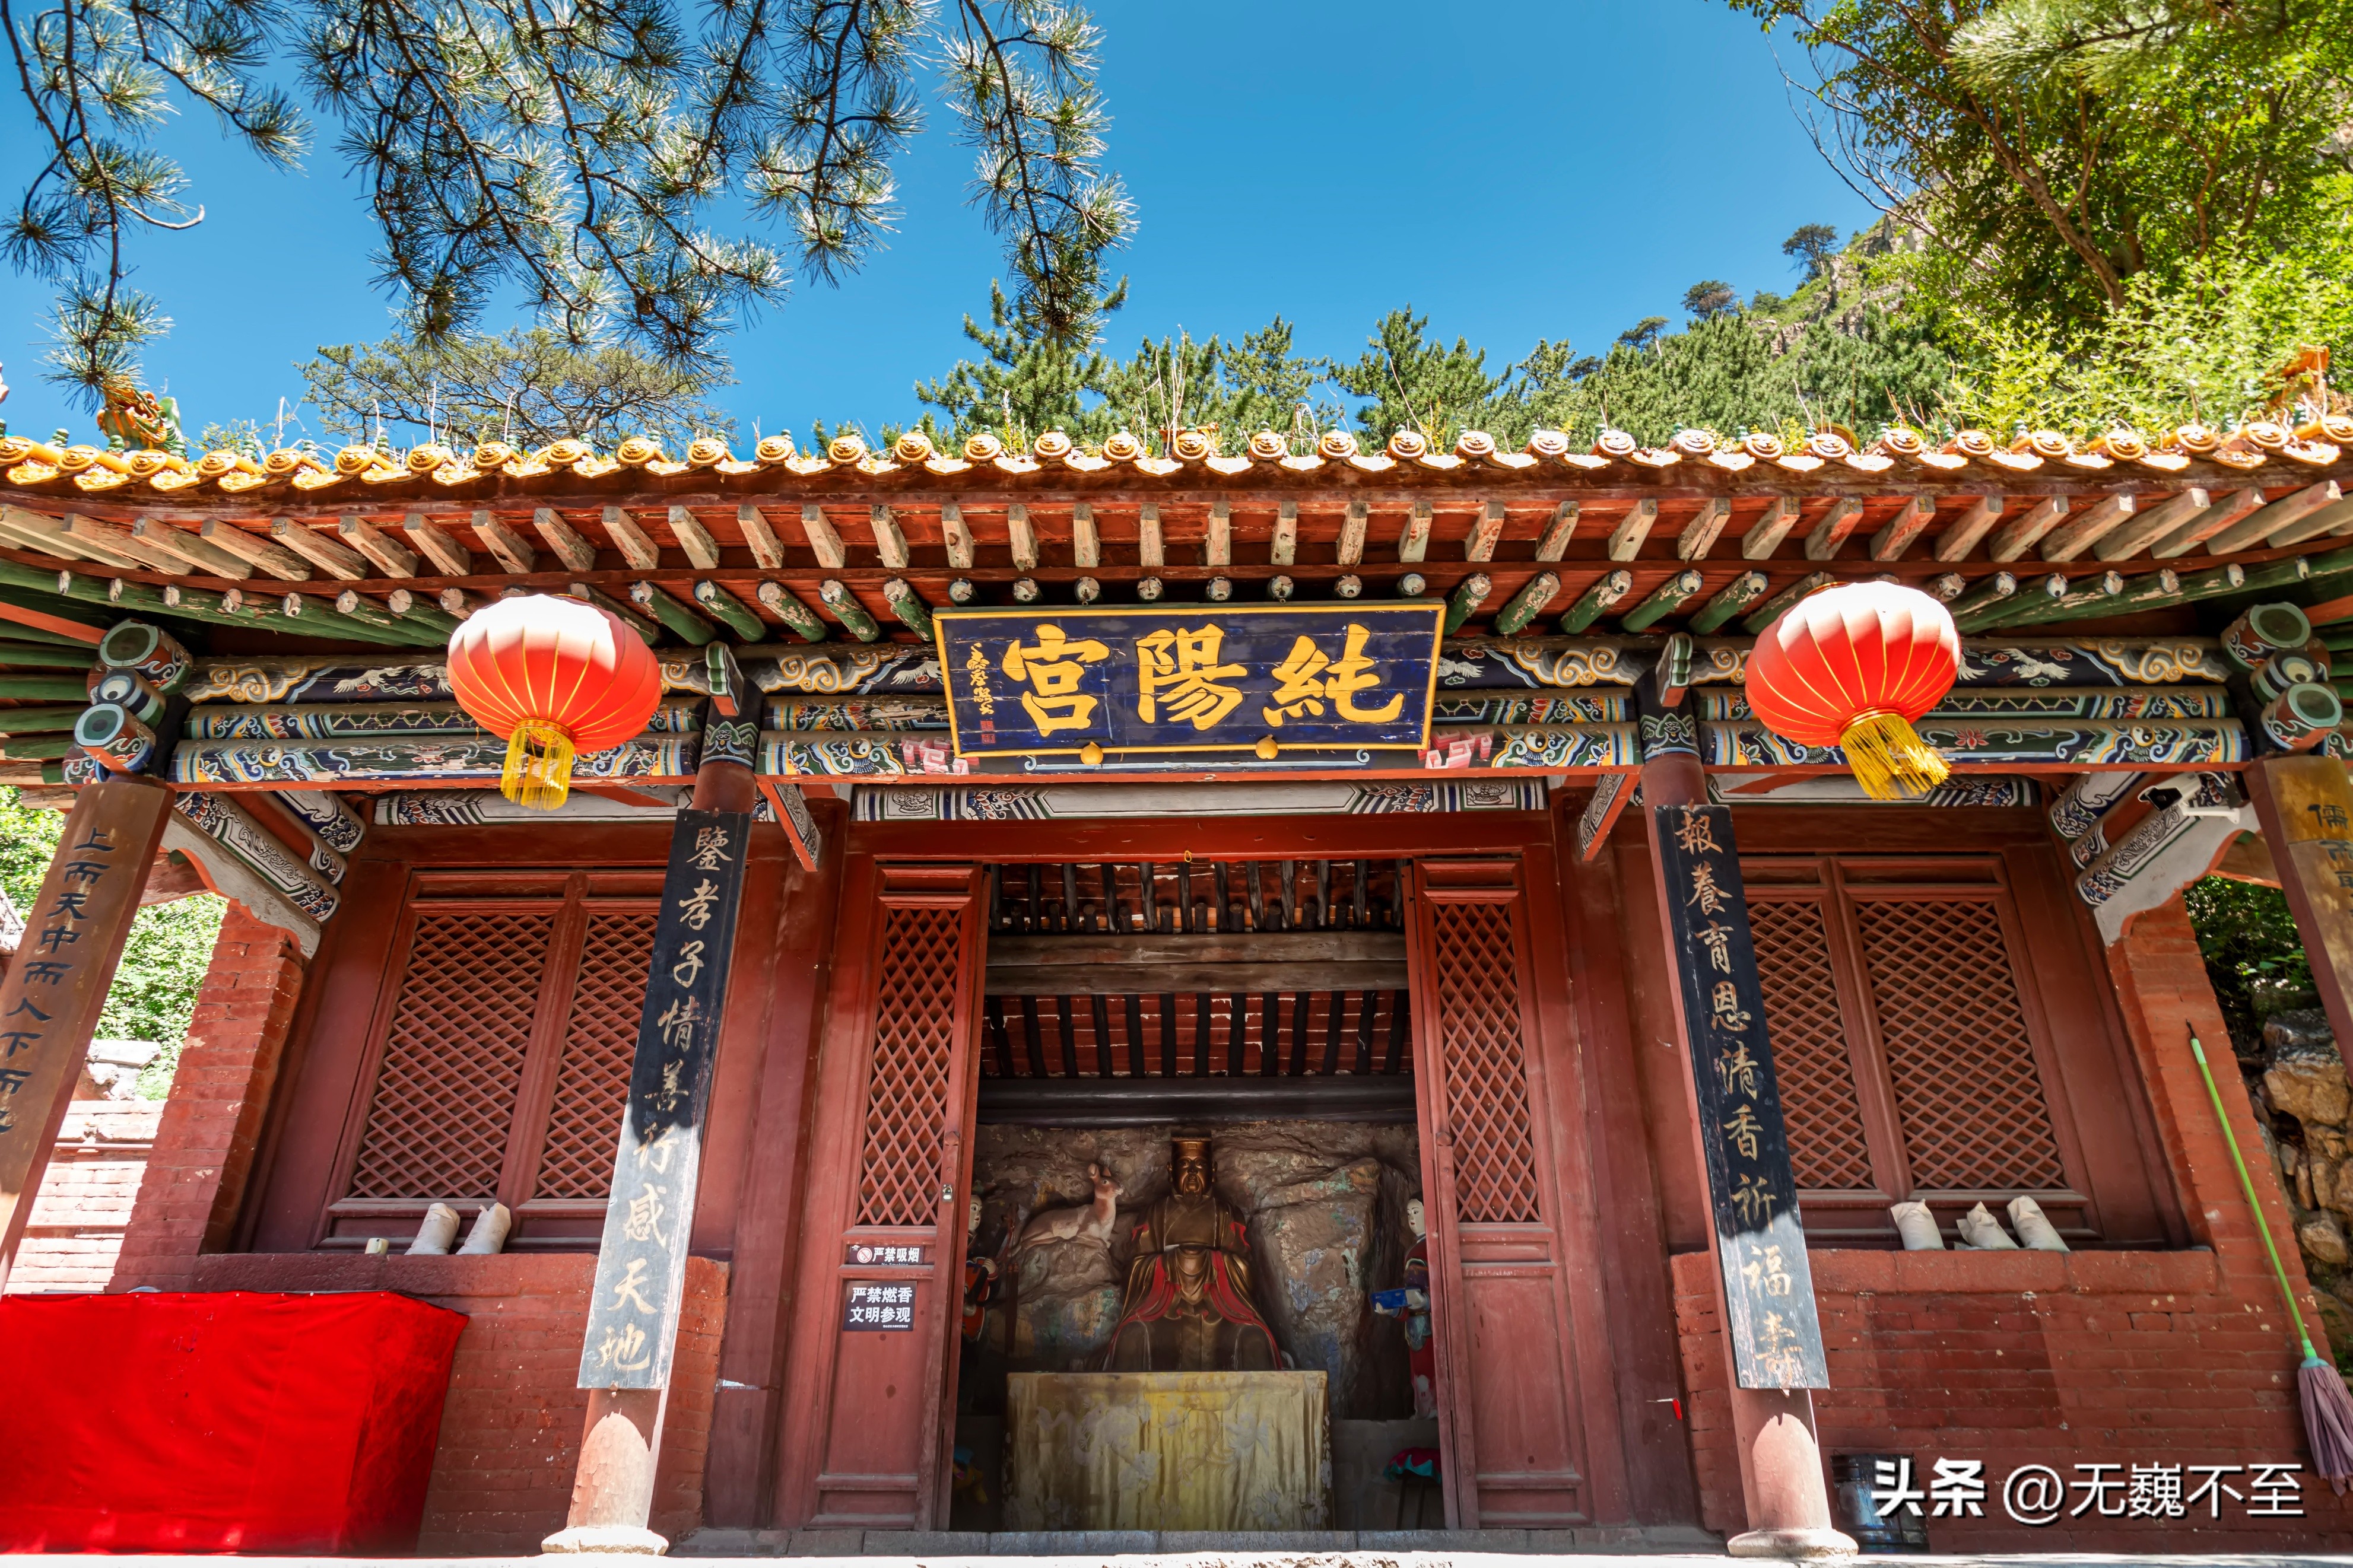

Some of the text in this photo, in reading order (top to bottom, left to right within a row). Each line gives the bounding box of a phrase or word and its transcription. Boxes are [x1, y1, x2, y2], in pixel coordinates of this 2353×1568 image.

[872, 1247, 920, 1262] 严禁吸烟
[851, 1287, 913, 1303] 严禁燃香
[849, 1306, 911, 1323] 文明参观
